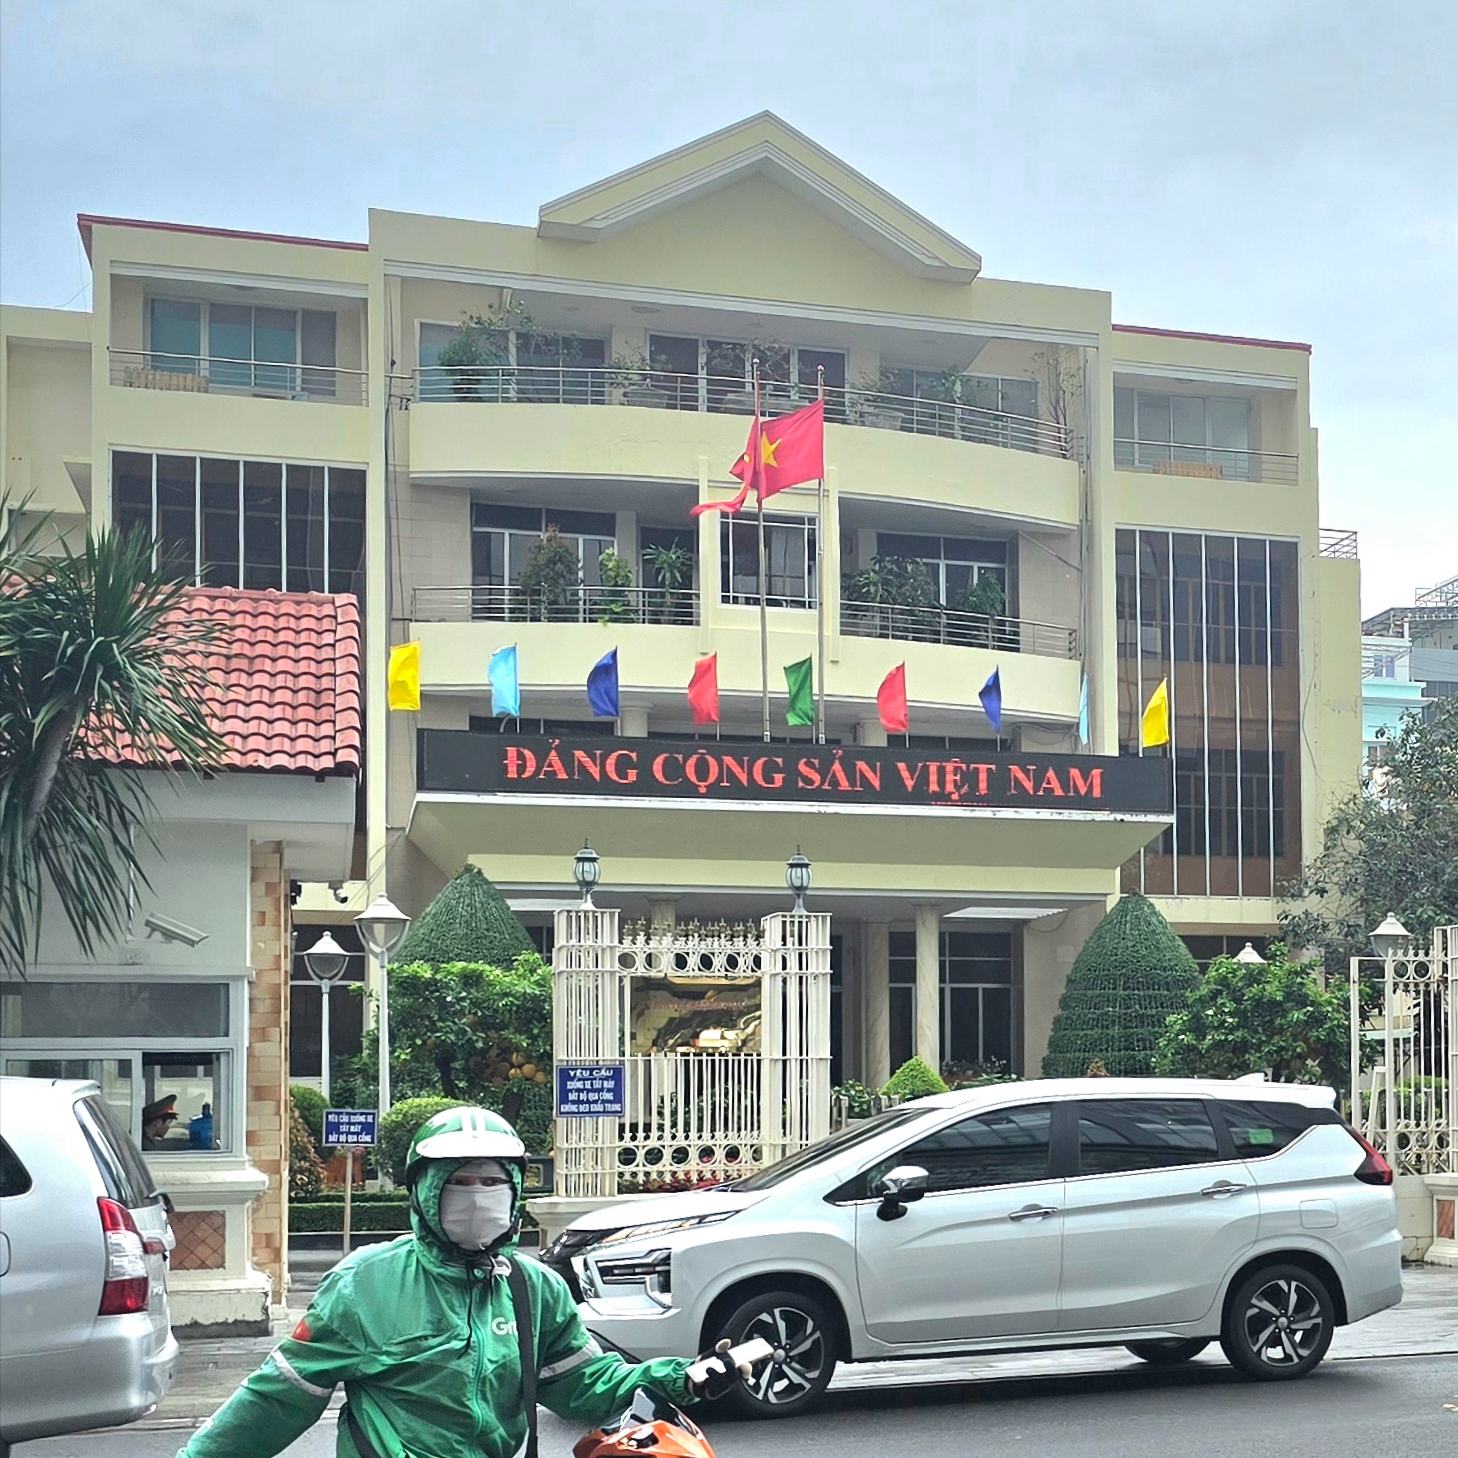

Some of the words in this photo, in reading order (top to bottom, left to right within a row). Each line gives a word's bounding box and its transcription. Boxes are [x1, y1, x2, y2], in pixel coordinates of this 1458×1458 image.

[503, 739, 638, 785] ĐẢNG
[652, 748, 786, 795] CỘNG
[798, 748, 881, 792] SẢN
[895, 758, 996, 801] VIỆT
[1008, 764, 1105, 799] NAM
[569, 1068, 590, 1077] YÊU
[491, 1316, 518, 1336] Gr
